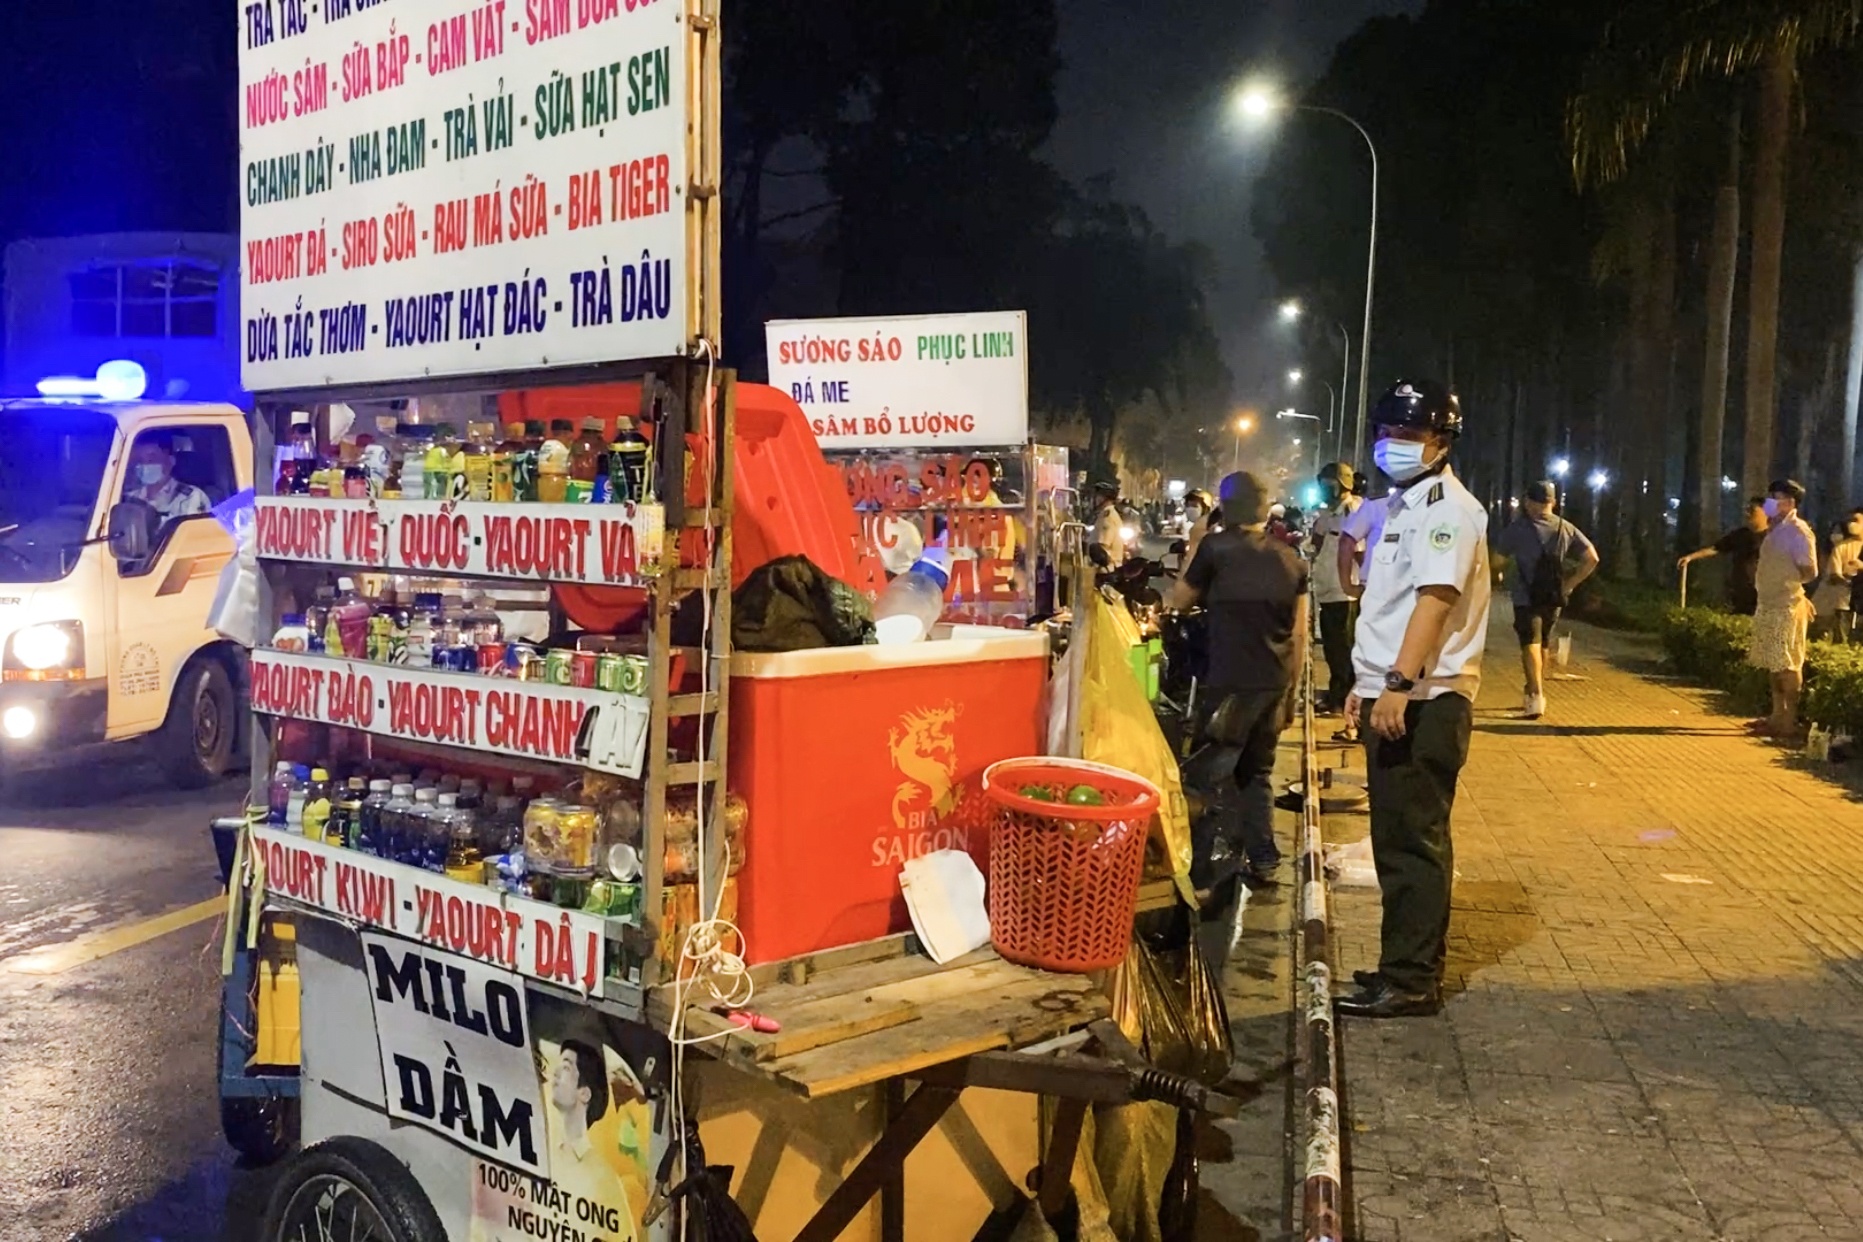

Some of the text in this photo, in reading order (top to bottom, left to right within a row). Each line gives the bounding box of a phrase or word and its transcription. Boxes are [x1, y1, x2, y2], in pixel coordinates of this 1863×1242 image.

[246, 67, 288, 129] NƯỚC
[294, 57, 327, 117] SÂM
[342, 41, 372, 102] SỮA
[376, 17, 410, 91] BẮP
[427, 14, 466, 77] CAM
[247, 153, 300, 206] CHANH
[305, 136, 334, 195] DÂY
[349, 130, 381, 185] NHA
[387, 118, 425, 176] ĐAM
[444, 93, 478, 162] TRÀ
[483, 76, 513, 152] VẢI
[535, 69, 575, 140] SỮA
[582, 61, 621, 137] HẠT
[628, 45, 670, 116] SEN
[247, 232, 303, 285] YAOURT
[307, 217, 327, 277] ĐÁ
[342, 216, 378, 271] SIRO
[383, 201, 416, 264] SỮA
[433, 198, 468, 254] RAU
[473, 178, 503, 247] MÁ
[509, 173, 548, 242] SỮA
[568, 169, 602, 231] BIA
[609, 153, 670, 223] TIGER
[247, 307, 278, 363] DỪA
[284, 294, 314, 359] TẮC
[319, 300, 366, 355] THƠM
[385, 291, 454, 348] YAOURT
[459, 284, 499, 351] HẠT
[503, 267, 547, 336] ĐÁC
[570, 255, 613, 328] TRÀ
[621, 248, 671, 323] DÂU
[779, 330, 1014, 365] SƯƠNG SÁO PHỤC LINH
[791, 376, 849, 404] ĐÁ ME
[812, 406, 975, 438] SÂM BỔ LƯỢNG
[254, 505, 337, 560] YAOURT
[400, 501, 469, 570] QUỐC
[483, 514, 591, 581] YAOURT
[249, 660, 324, 719] YAOURT
[387, 679, 480, 744] YAOURT
[871, 825, 969, 867] SAIGON
[908, 811, 938, 830] BIA
[252, 836, 327, 907] OURT
[335, 860, 397, 930] KIWI
[415, 885, 524, 972] YAOURT
[368, 944, 526, 1048] MILO
[393, 1040, 538, 1167] DẦM
[479, 1163, 619, 1233] 100% MẬT ONG
